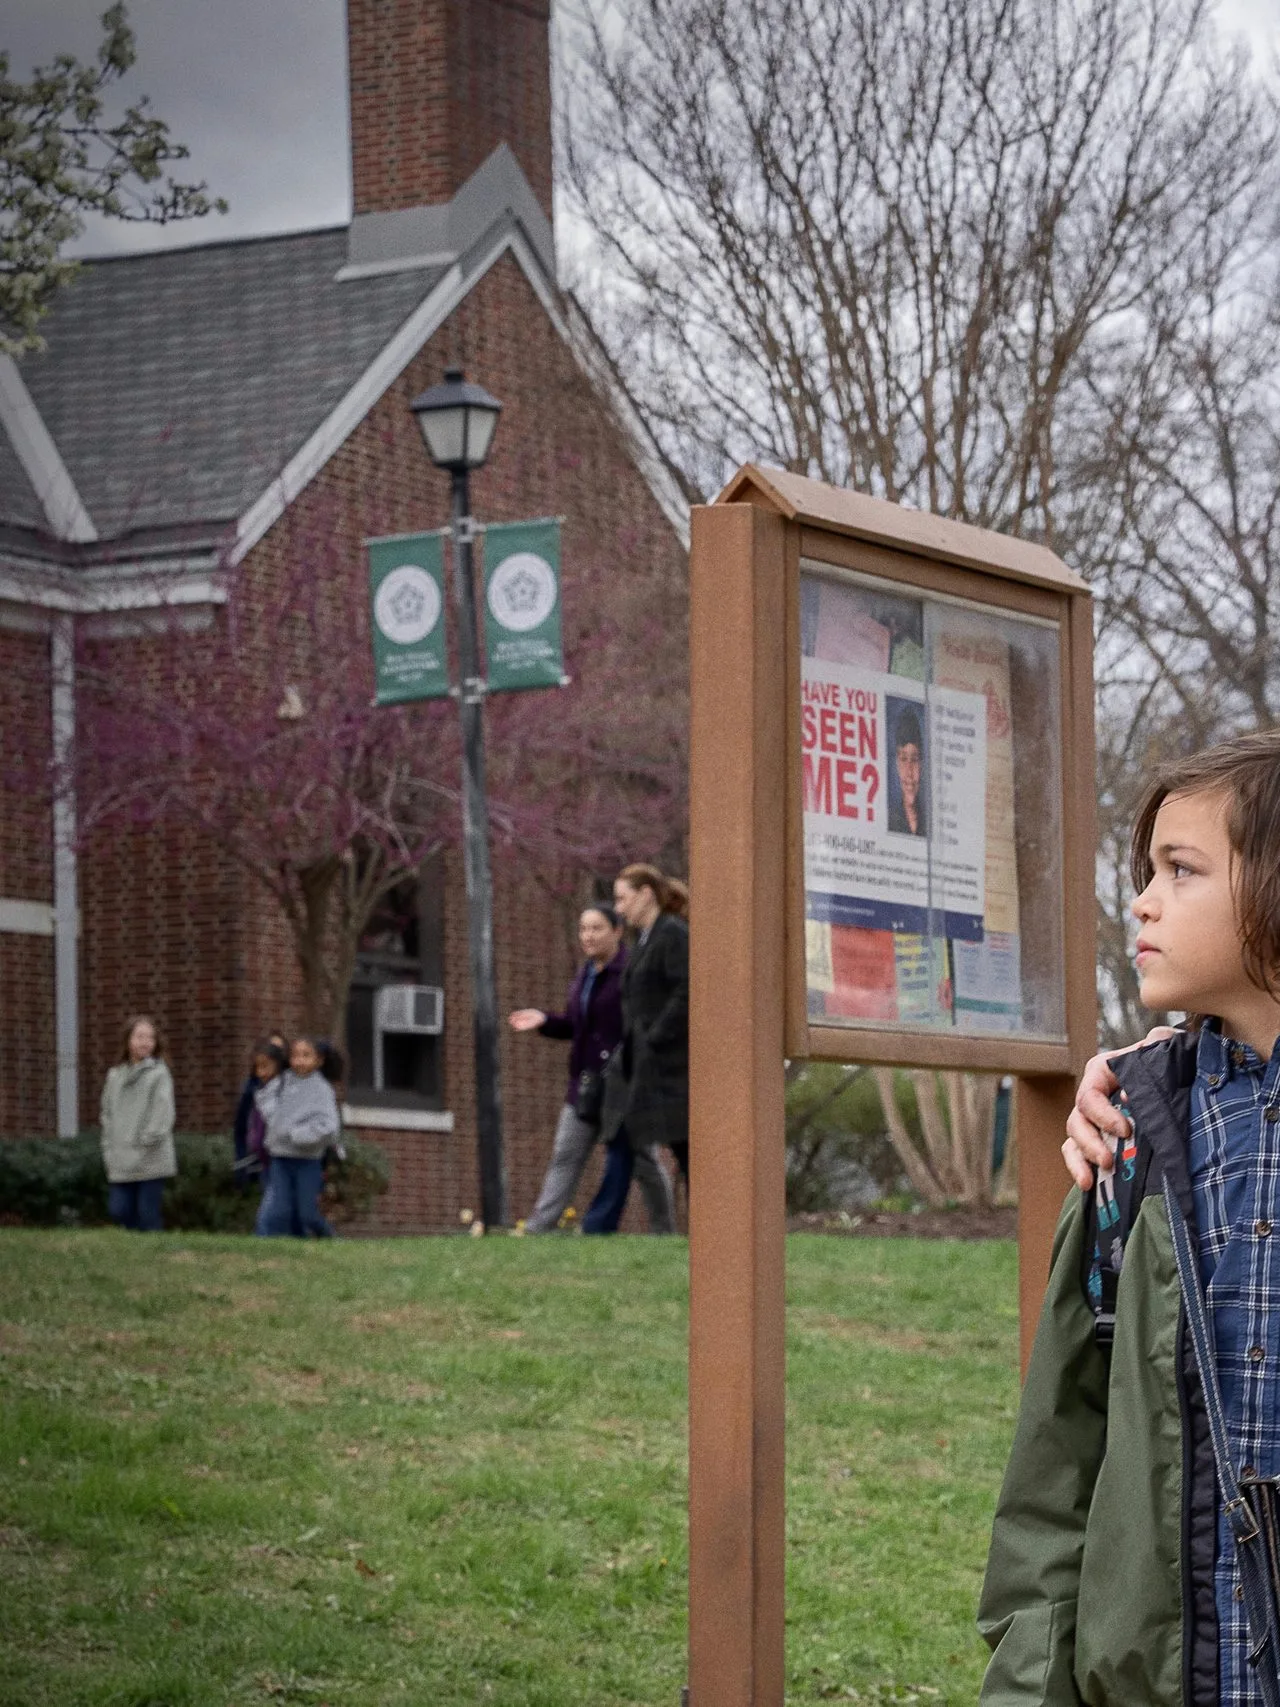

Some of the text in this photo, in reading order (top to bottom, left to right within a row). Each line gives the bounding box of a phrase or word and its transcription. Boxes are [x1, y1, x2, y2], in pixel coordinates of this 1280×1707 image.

[801, 680, 877, 713] HAVE YOU
[801, 704, 877, 760] SEEN
[802, 753, 879, 822] ME?
